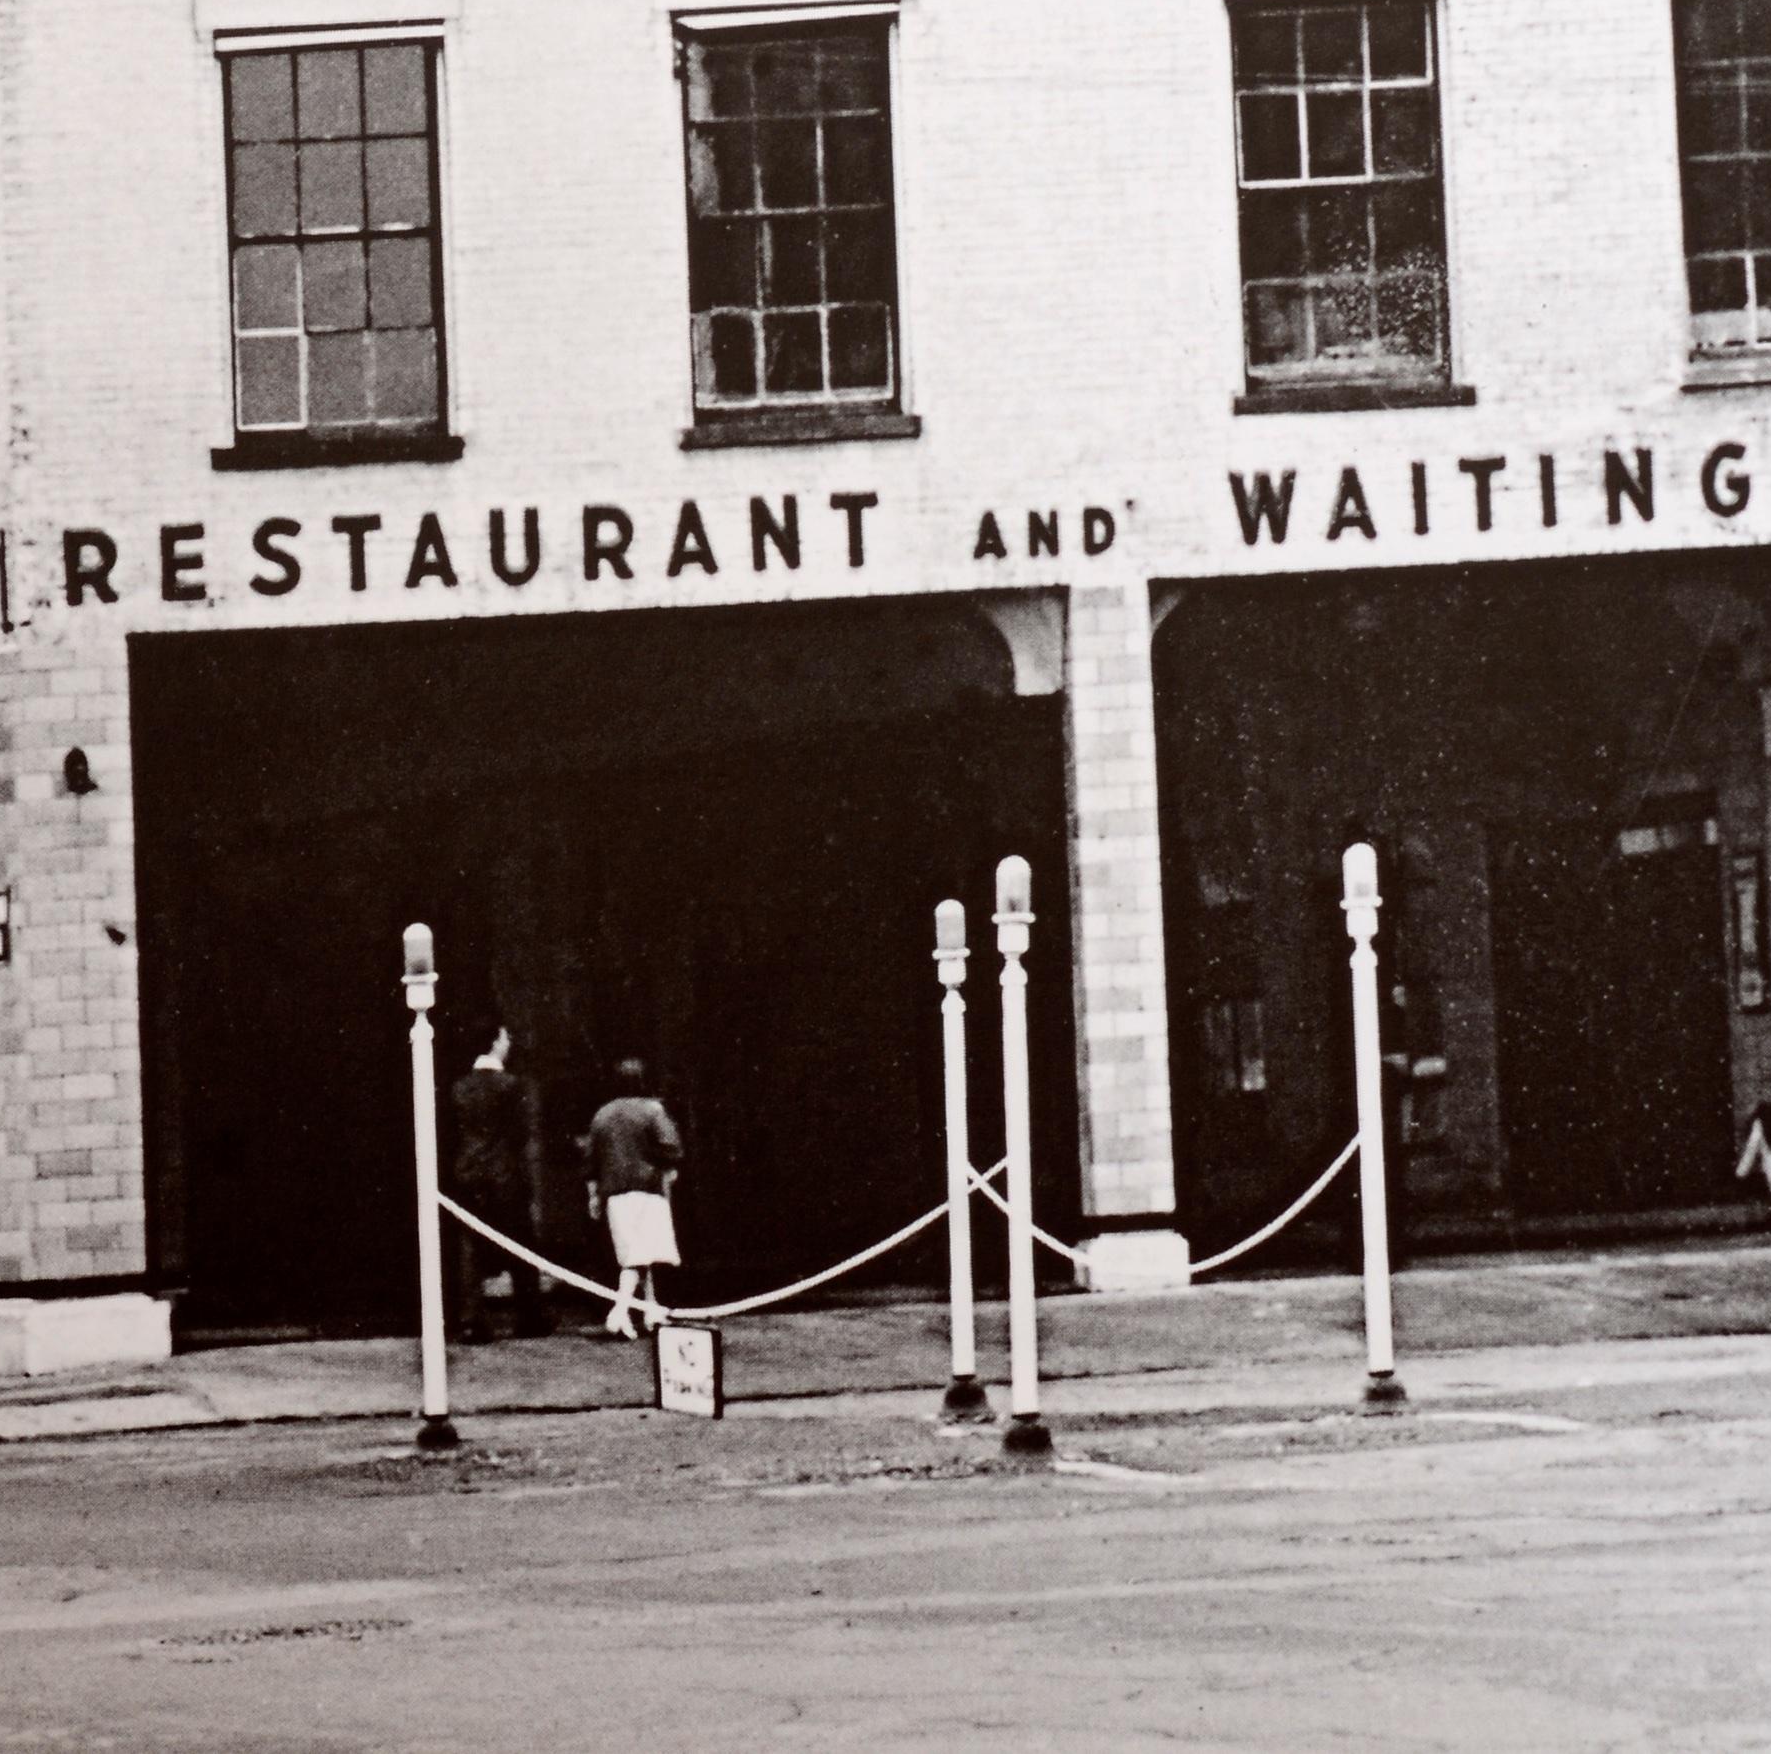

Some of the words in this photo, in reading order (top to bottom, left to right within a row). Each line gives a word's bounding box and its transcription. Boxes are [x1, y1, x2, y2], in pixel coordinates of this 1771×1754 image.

[63, 493, 879, 606] RESTAURANT
[972, 507, 1117, 559] AND
[1229, 443, 1751, 545] WAITING
